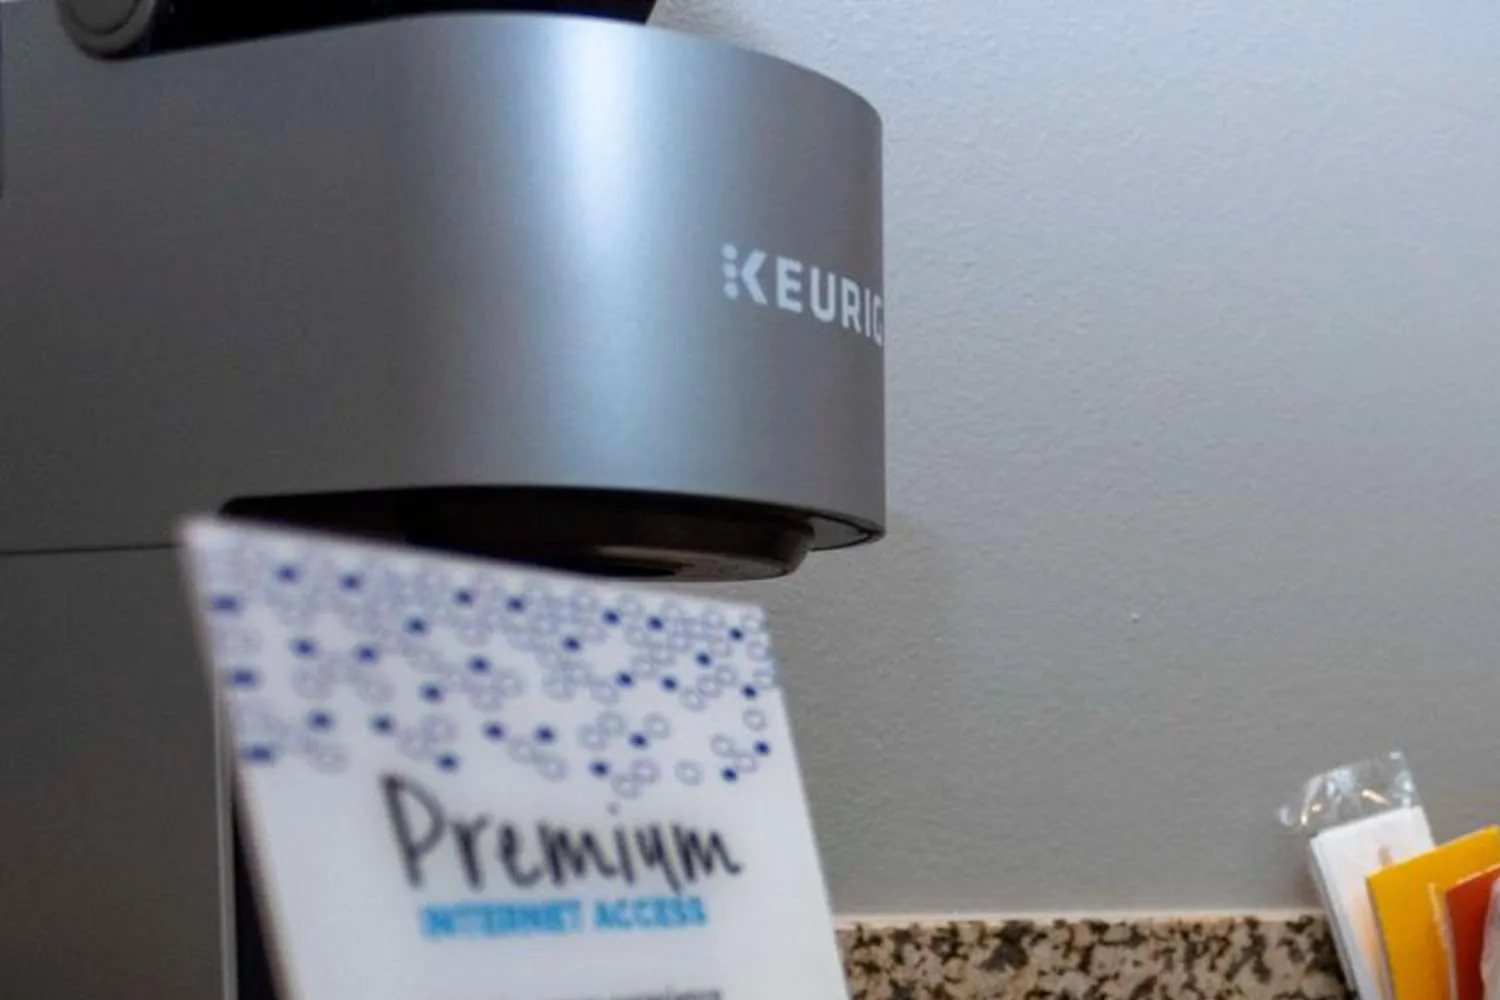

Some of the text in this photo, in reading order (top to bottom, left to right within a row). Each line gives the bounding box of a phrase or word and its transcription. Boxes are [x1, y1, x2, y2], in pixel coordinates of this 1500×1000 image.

[380, 771, 744, 893] Premium
[420, 895, 708, 940] INTERNET ACCESS
